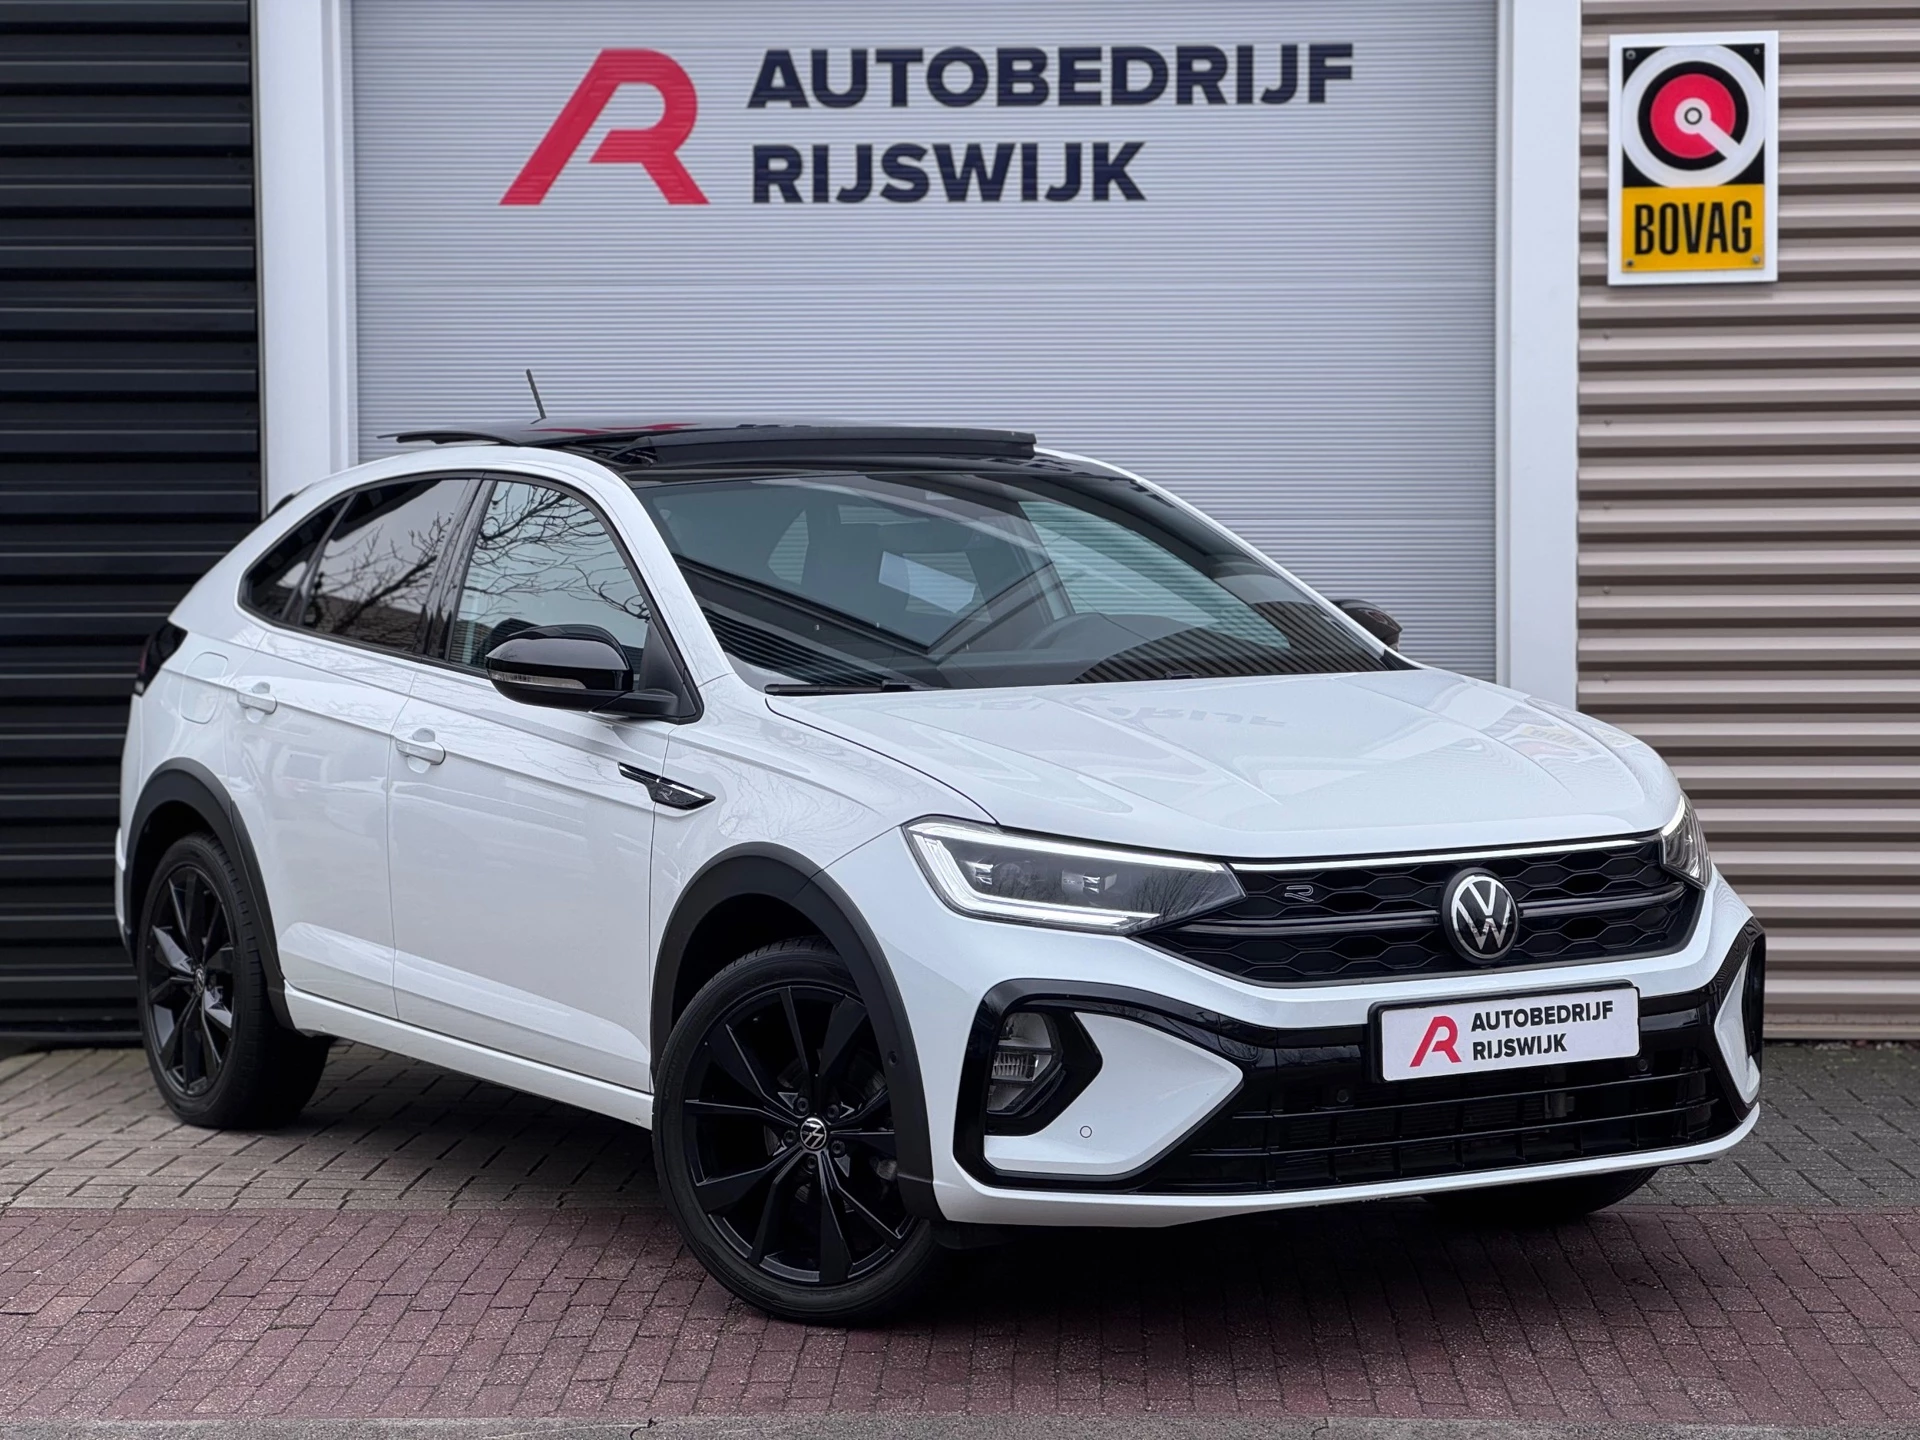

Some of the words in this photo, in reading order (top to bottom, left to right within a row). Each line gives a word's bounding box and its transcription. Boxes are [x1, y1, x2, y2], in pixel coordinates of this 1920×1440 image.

[747, 43, 1354, 109] AUTOBEDRIJF
[753, 141, 1146, 204] RIJSWIJK
[1634, 200, 1752, 255] BOVAG
[1470, 1000, 1613, 1033] AUTOBEDRIJF
[1472, 1033, 1568, 1061] RIJSWIJK
